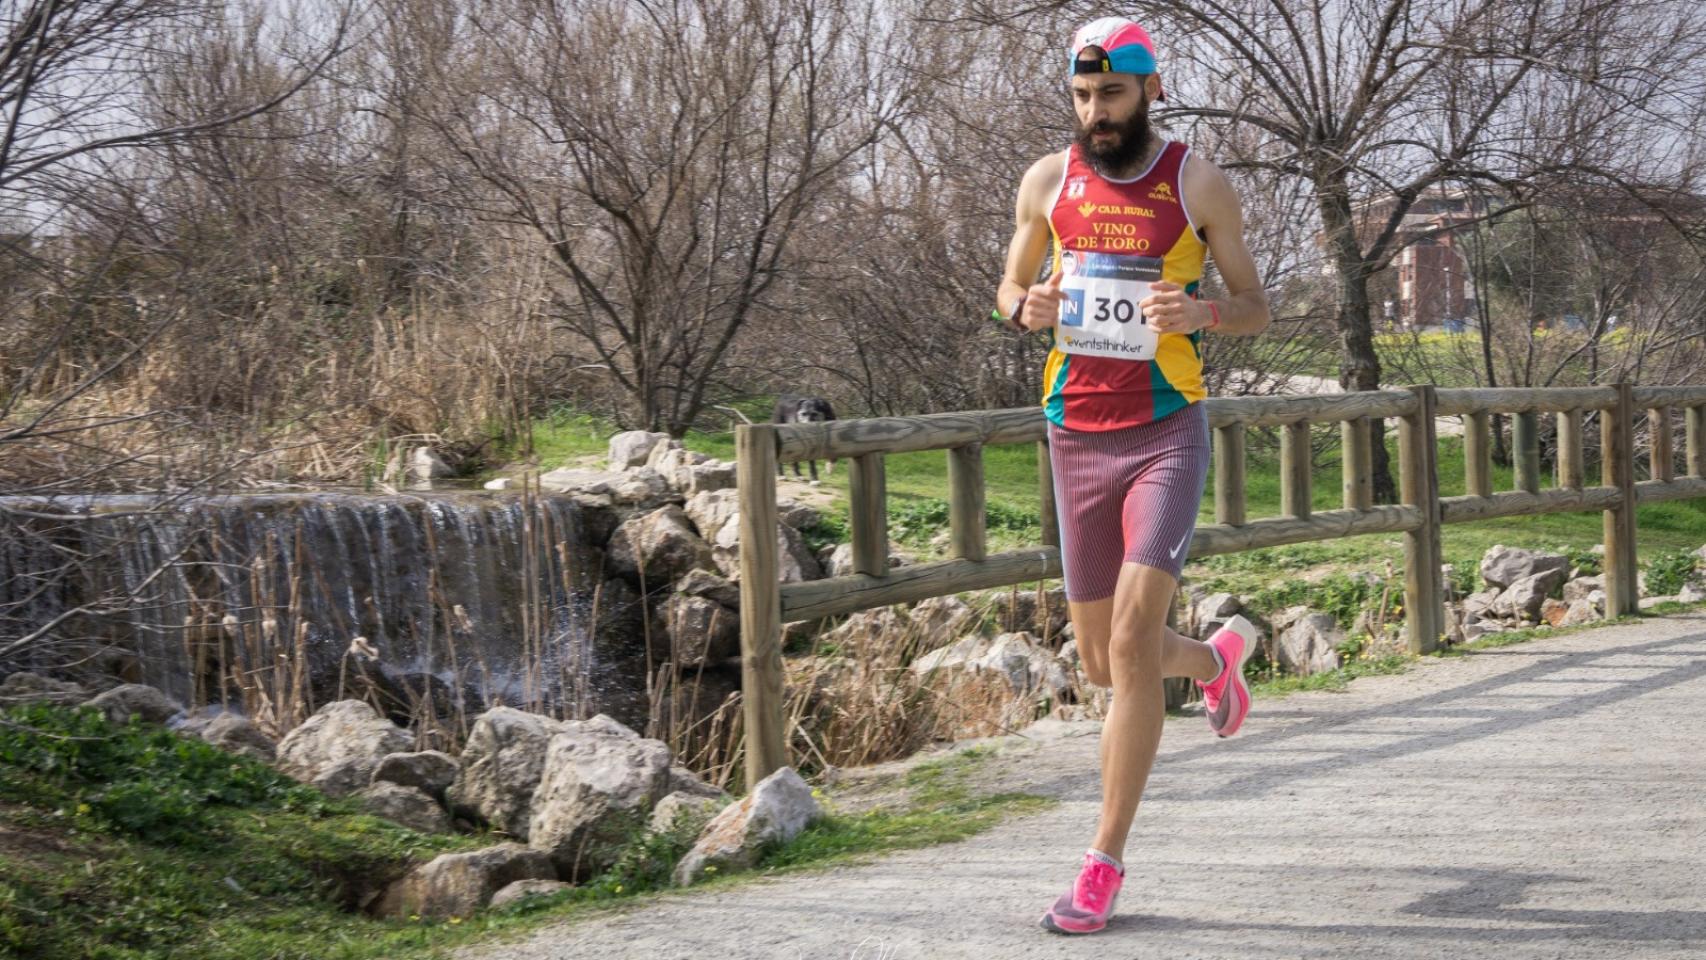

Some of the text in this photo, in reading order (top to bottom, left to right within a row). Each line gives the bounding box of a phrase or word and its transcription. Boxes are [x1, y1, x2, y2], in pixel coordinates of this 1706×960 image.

[1098, 205, 1156, 218] CAJA RURAL
[1092, 223, 1136, 236] VINO
[1077, 237, 1150, 251] DE TORO
